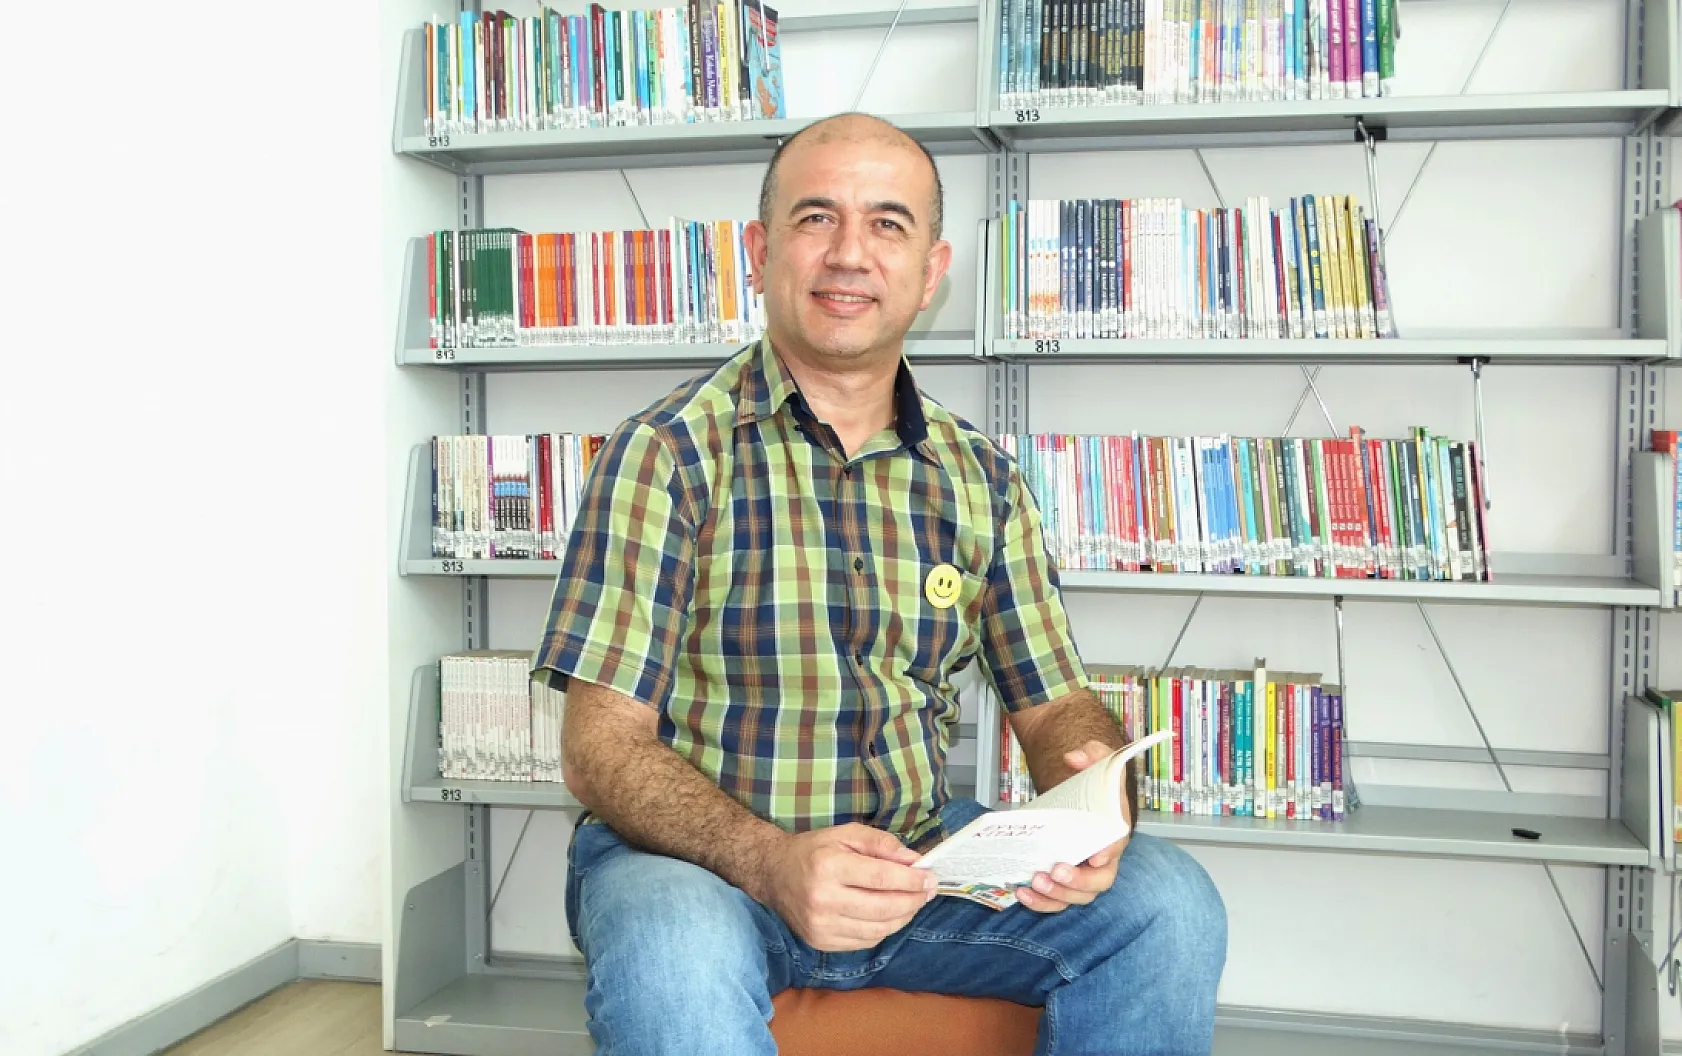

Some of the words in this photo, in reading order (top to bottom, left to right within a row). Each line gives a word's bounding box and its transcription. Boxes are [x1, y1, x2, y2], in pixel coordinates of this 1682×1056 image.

[1015, 109, 1040, 123] 813
[429, 136, 450, 147] 813
[1035, 339, 1061, 353] 813
[435, 348, 456, 360] 813
[442, 560, 464, 573] 813
[441, 788, 462, 801] 813
